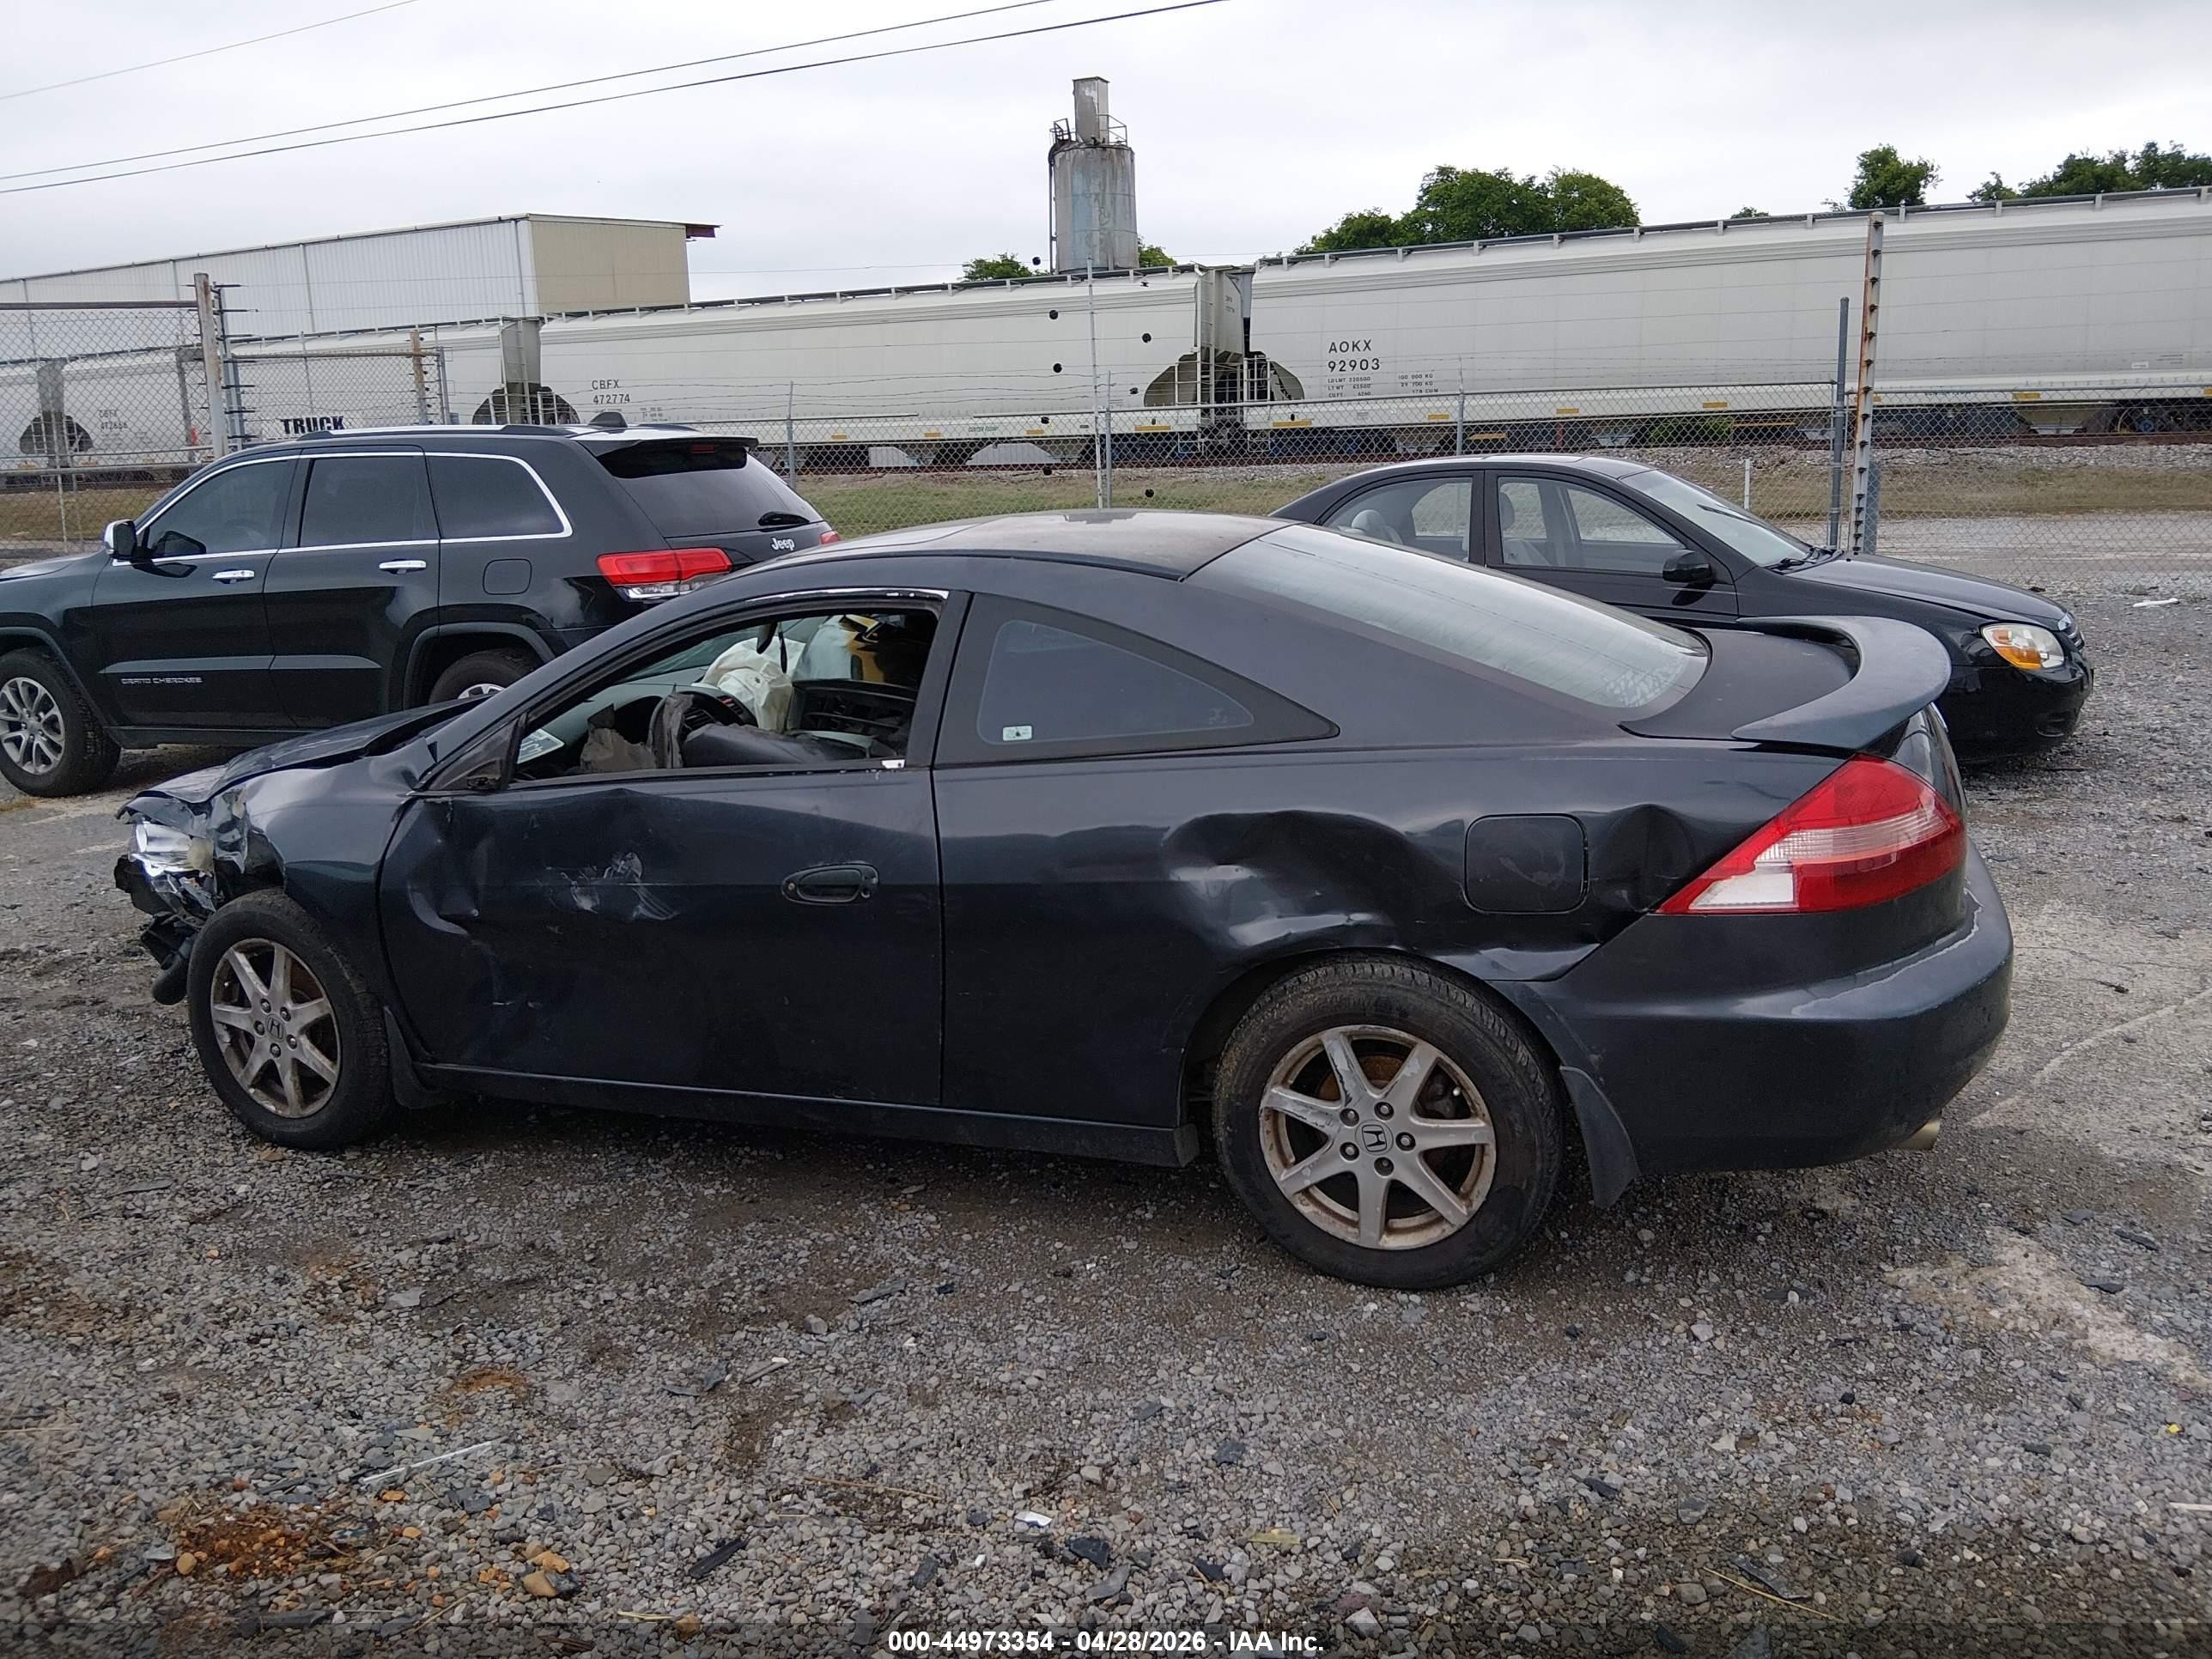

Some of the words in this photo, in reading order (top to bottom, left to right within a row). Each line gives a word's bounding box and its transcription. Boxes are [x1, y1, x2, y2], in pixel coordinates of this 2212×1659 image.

[1328, 338, 1372, 354] AOKX
[1328, 357, 1380, 373] 92903
[592, 379, 619, 390] CBFX
[592, 393, 630, 405] 472774
[280, 416, 345, 434] TRUCK
[771, 537, 795, 551] Jeep
